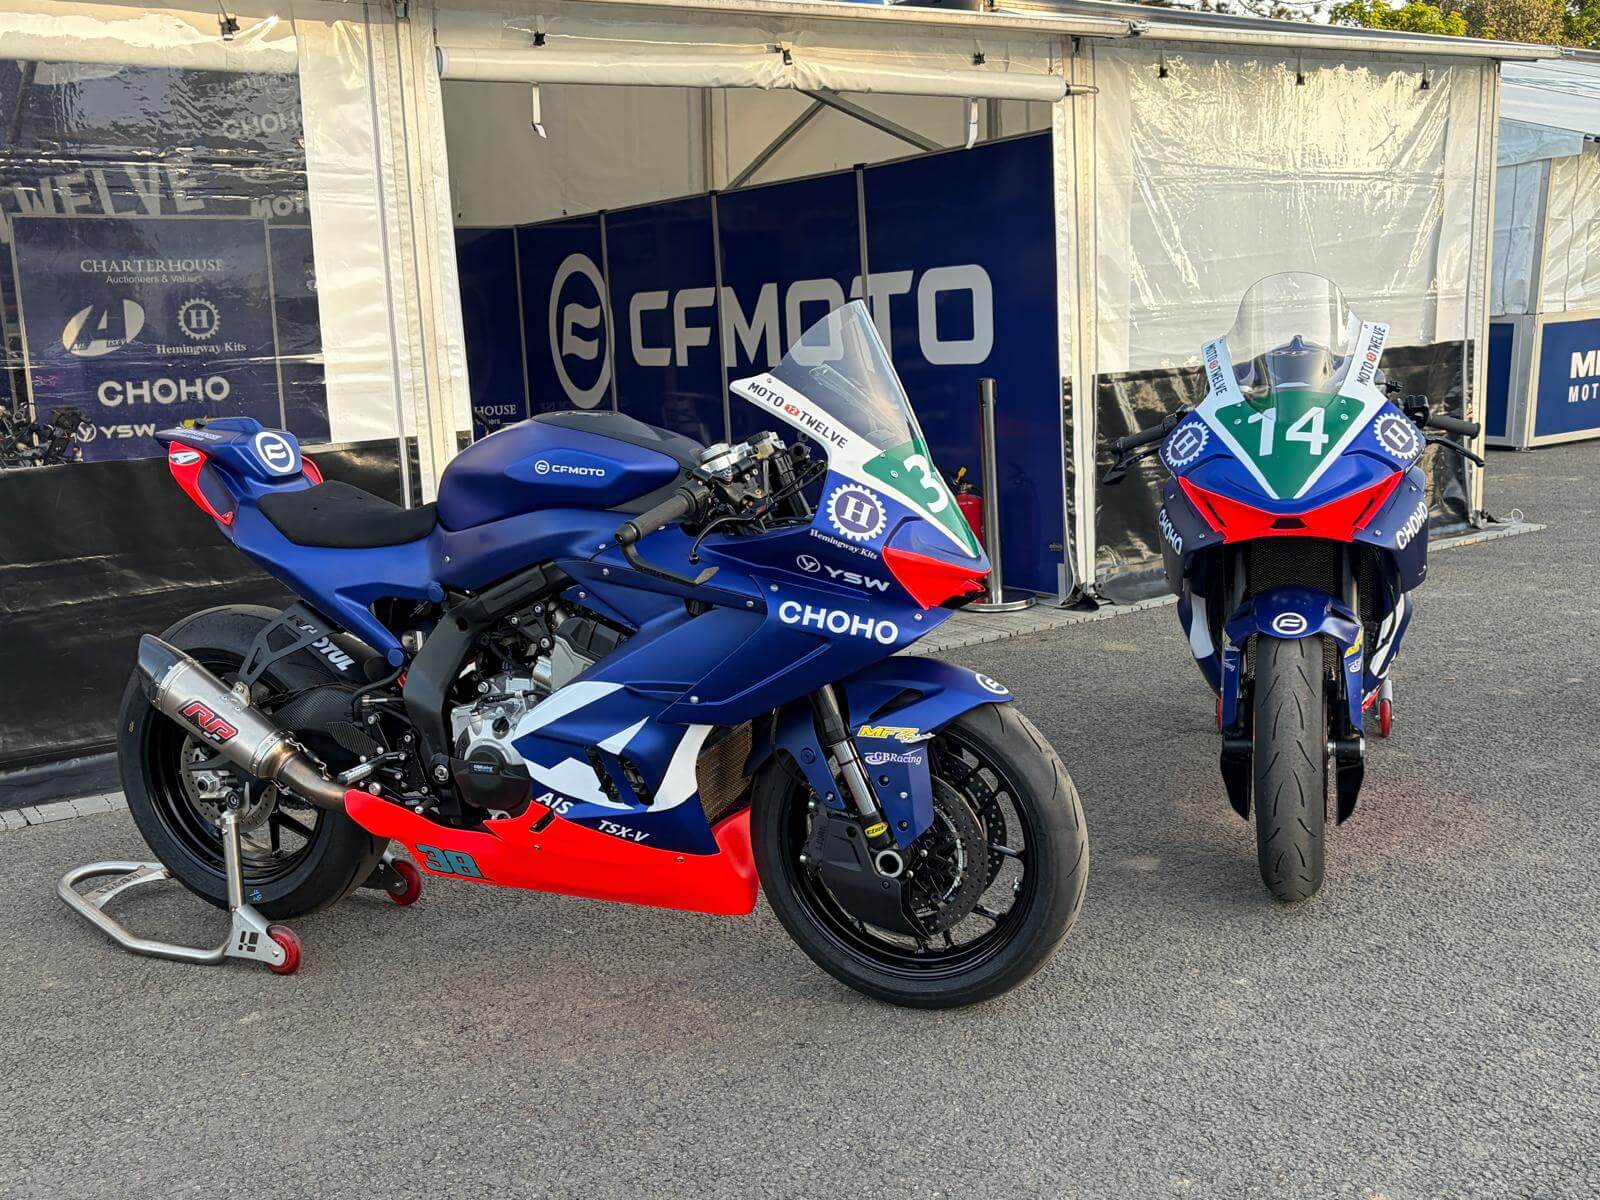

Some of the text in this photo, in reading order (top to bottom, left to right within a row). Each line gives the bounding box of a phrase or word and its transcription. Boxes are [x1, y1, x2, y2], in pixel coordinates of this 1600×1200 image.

[80, 258, 224, 273] CHARTERHOUSE
[106, 274, 159, 285] Auctioneers
[629, 264, 994, 368] CFMOTO
[155, 342, 247, 355] Hemingway Kits
[1356, 361, 1374, 386] MOTO
[1368, 325, 1386, 354] TWELVE
[98, 376, 230, 406] CHOHO
[747, 382, 785, 407] MOTO
[799, 410, 848, 448] TWELVE
[100, 423, 156, 439] YSW
[1248, 406, 1329, 456] 14
[552, 465, 605, 477] CFMOTO
[903, 454, 949, 513] 3
[1158, 508, 1183, 556] CHOHO
[1395, 501, 1429, 550] CHOHO
[810, 529, 878, 560] Hemingway Kits
[824, 565, 890, 592] YSW
[778, 601, 899, 645] CHOHO
[536, 791, 576, 814] AIS
[598, 820, 650, 842] TSX-V
[416, 843, 484, 878] 38
